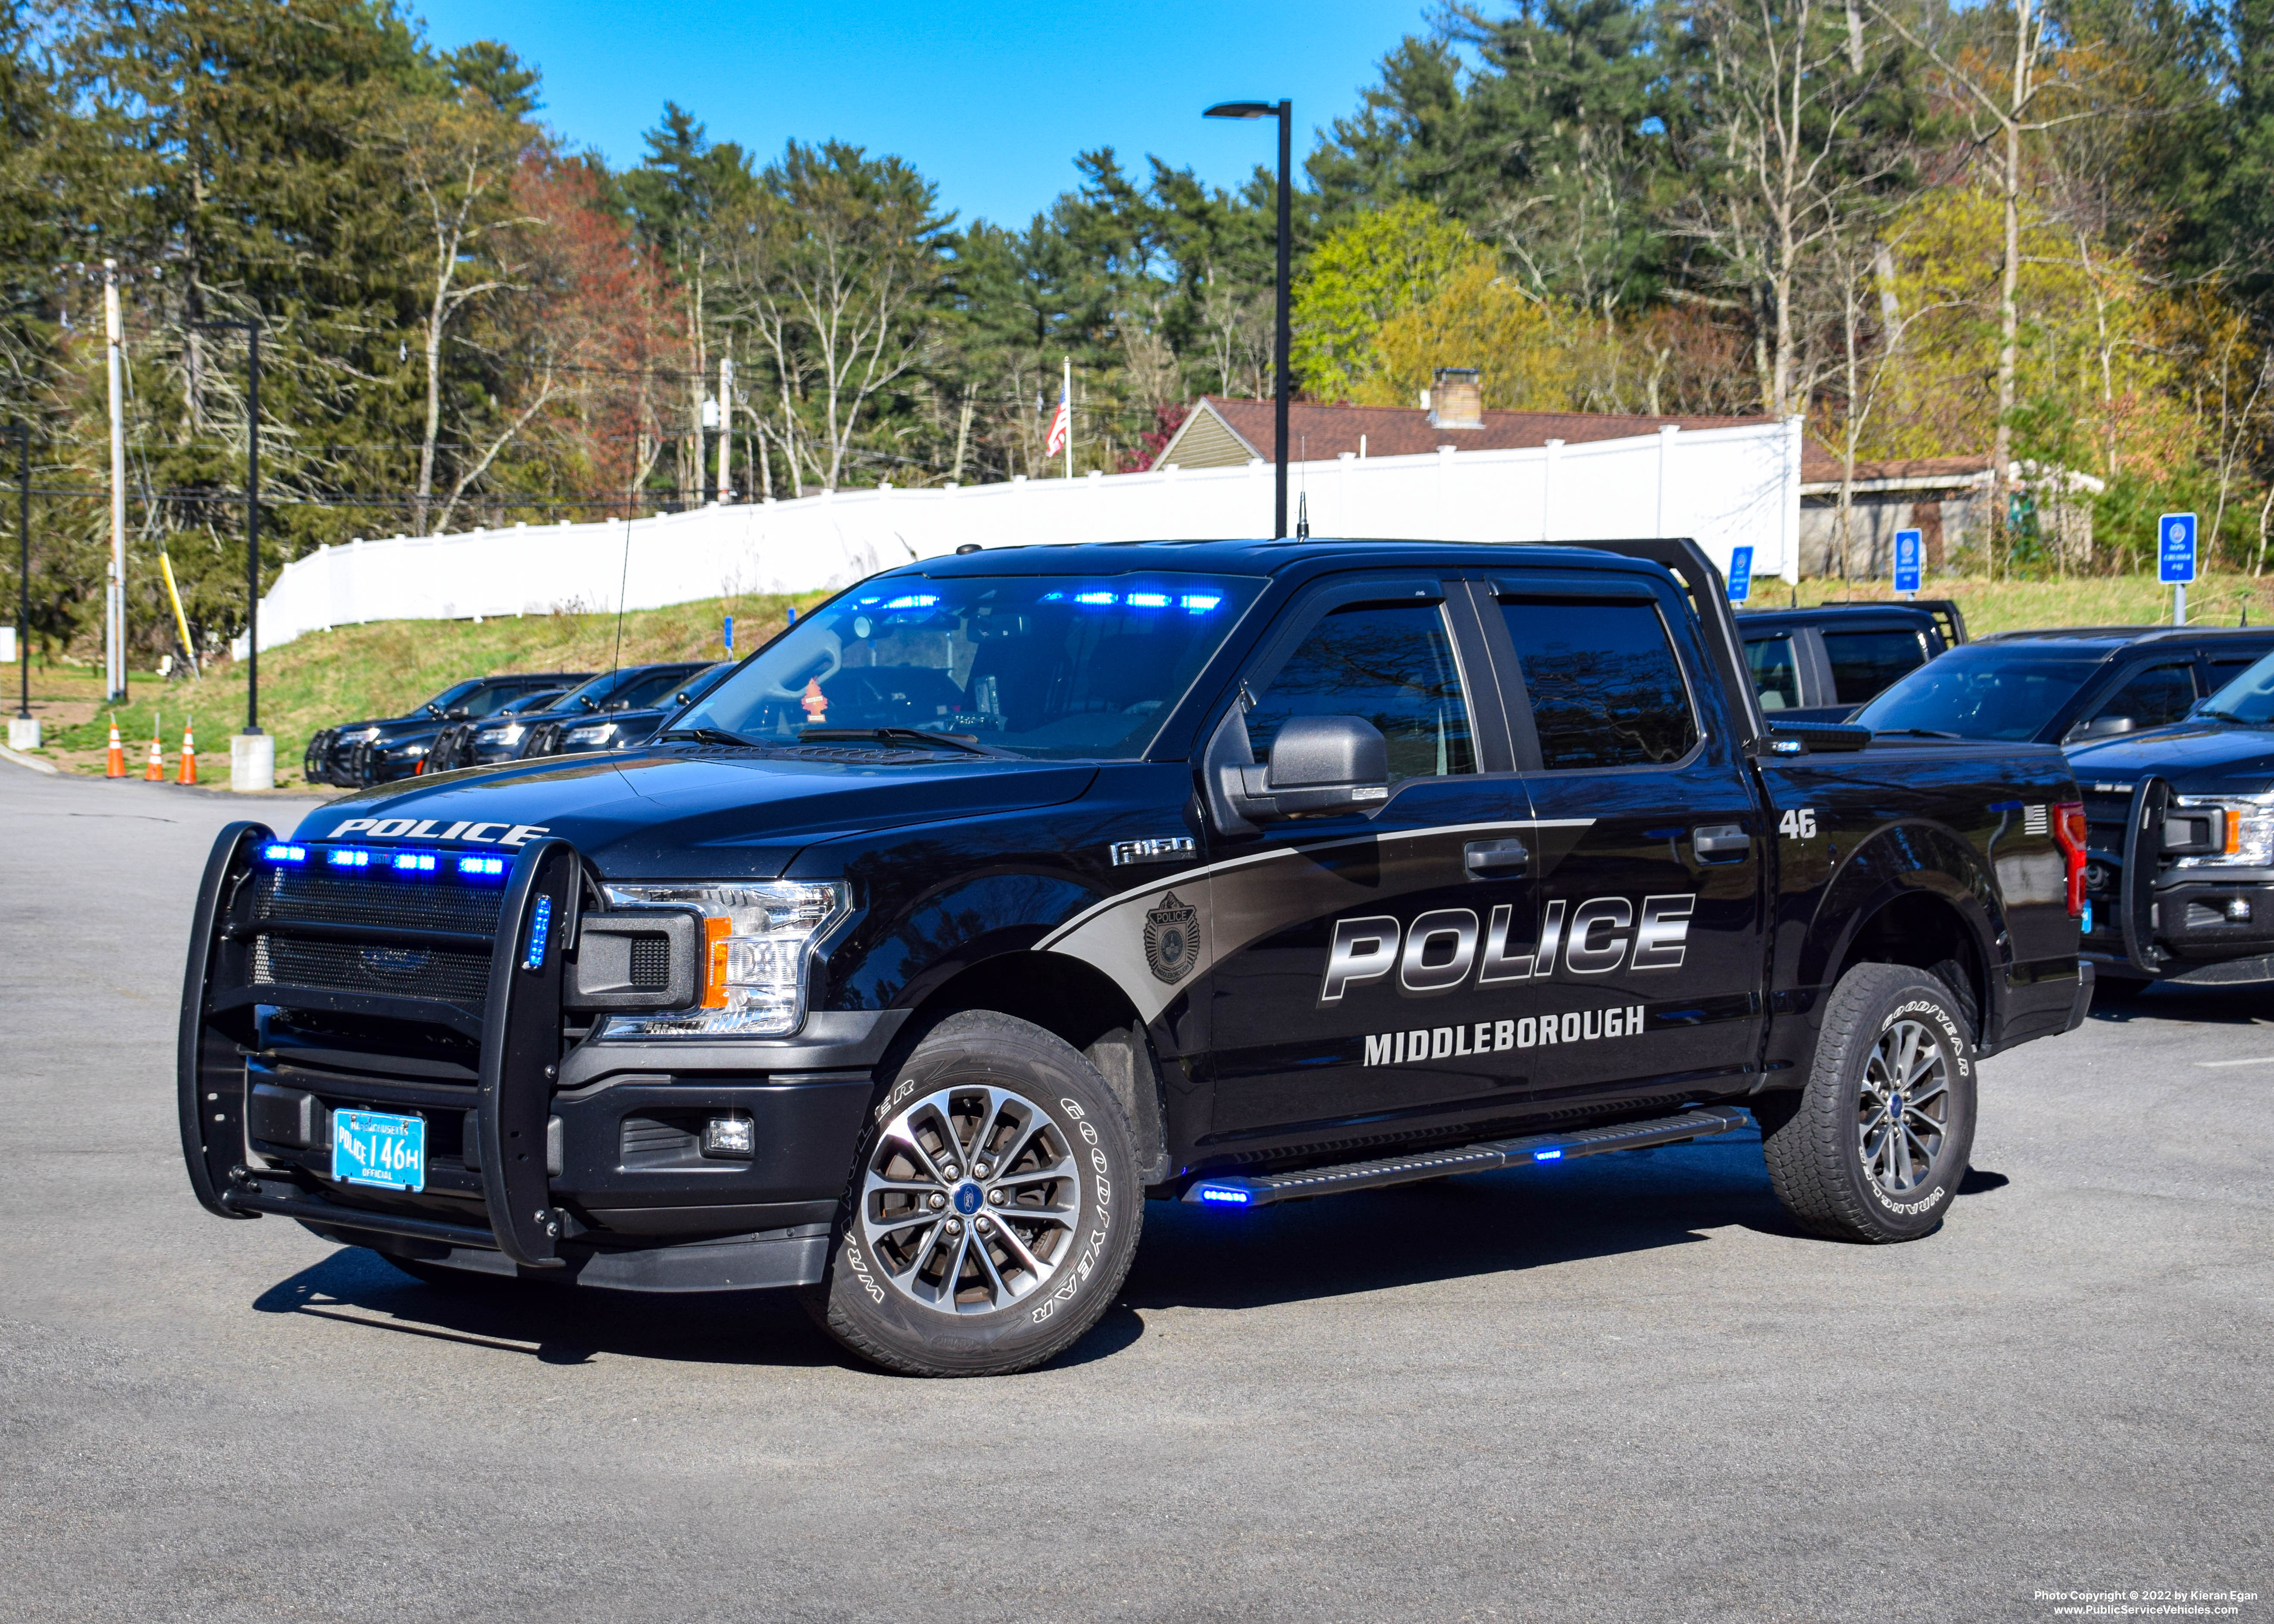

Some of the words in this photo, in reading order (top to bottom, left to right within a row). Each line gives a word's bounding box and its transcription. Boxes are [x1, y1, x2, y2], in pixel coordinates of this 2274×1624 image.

[326, 818, 551, 846] POLICE
[1779, 808, 1817, 839] 46
[1157, 911, 1187, 923] POLICE
[1319, 893, 1696, 1003] POLICE
[1363, 1006, 1645, 1067] MIDDLEBOROUGH
[1881, 1000, 1969, 1077] GOODYEAR
[339, 1125, 366, 1165] POLICE
[362, 1168, 393, 1180] OFFICIAL
[1858, 1146, 1945, 1215] WRANGLER
[1032, 1097, 1110, 1323] GOODYEAR
